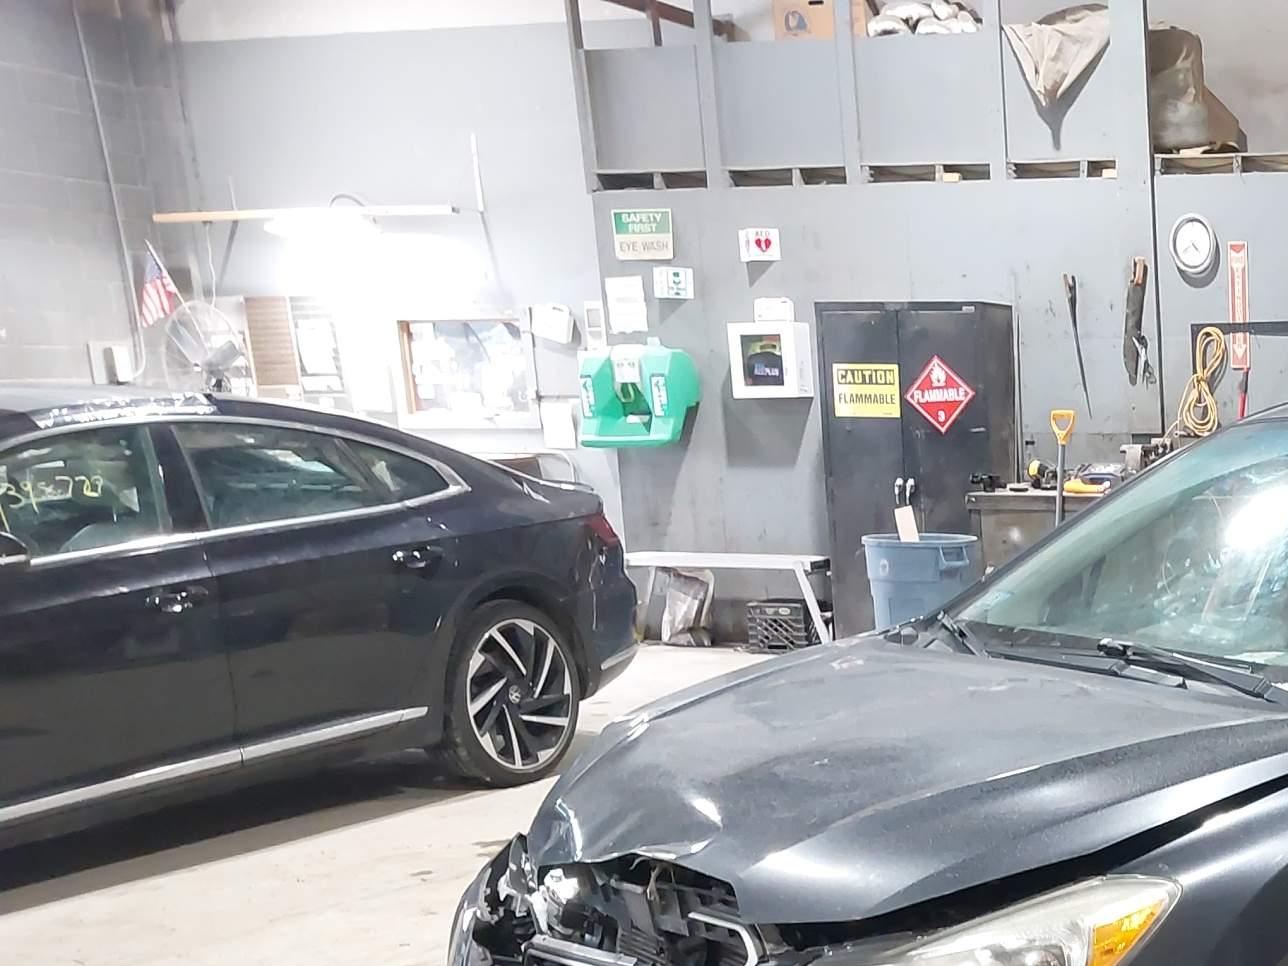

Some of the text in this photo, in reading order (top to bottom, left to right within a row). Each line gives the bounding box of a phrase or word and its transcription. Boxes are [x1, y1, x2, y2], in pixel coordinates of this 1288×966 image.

[622, 213, 662, 224] SAFETY
[628, 224, 657, 233] FIRST
[619, 240, 669, 252] EYE WASH
[837, 369, 894, 385] CAUTION
[838, 393, 896, 405] FLAMMABLE
[914, 387, 966, 403] FLAMMABLE
[937, 410, 946, 422] 3
